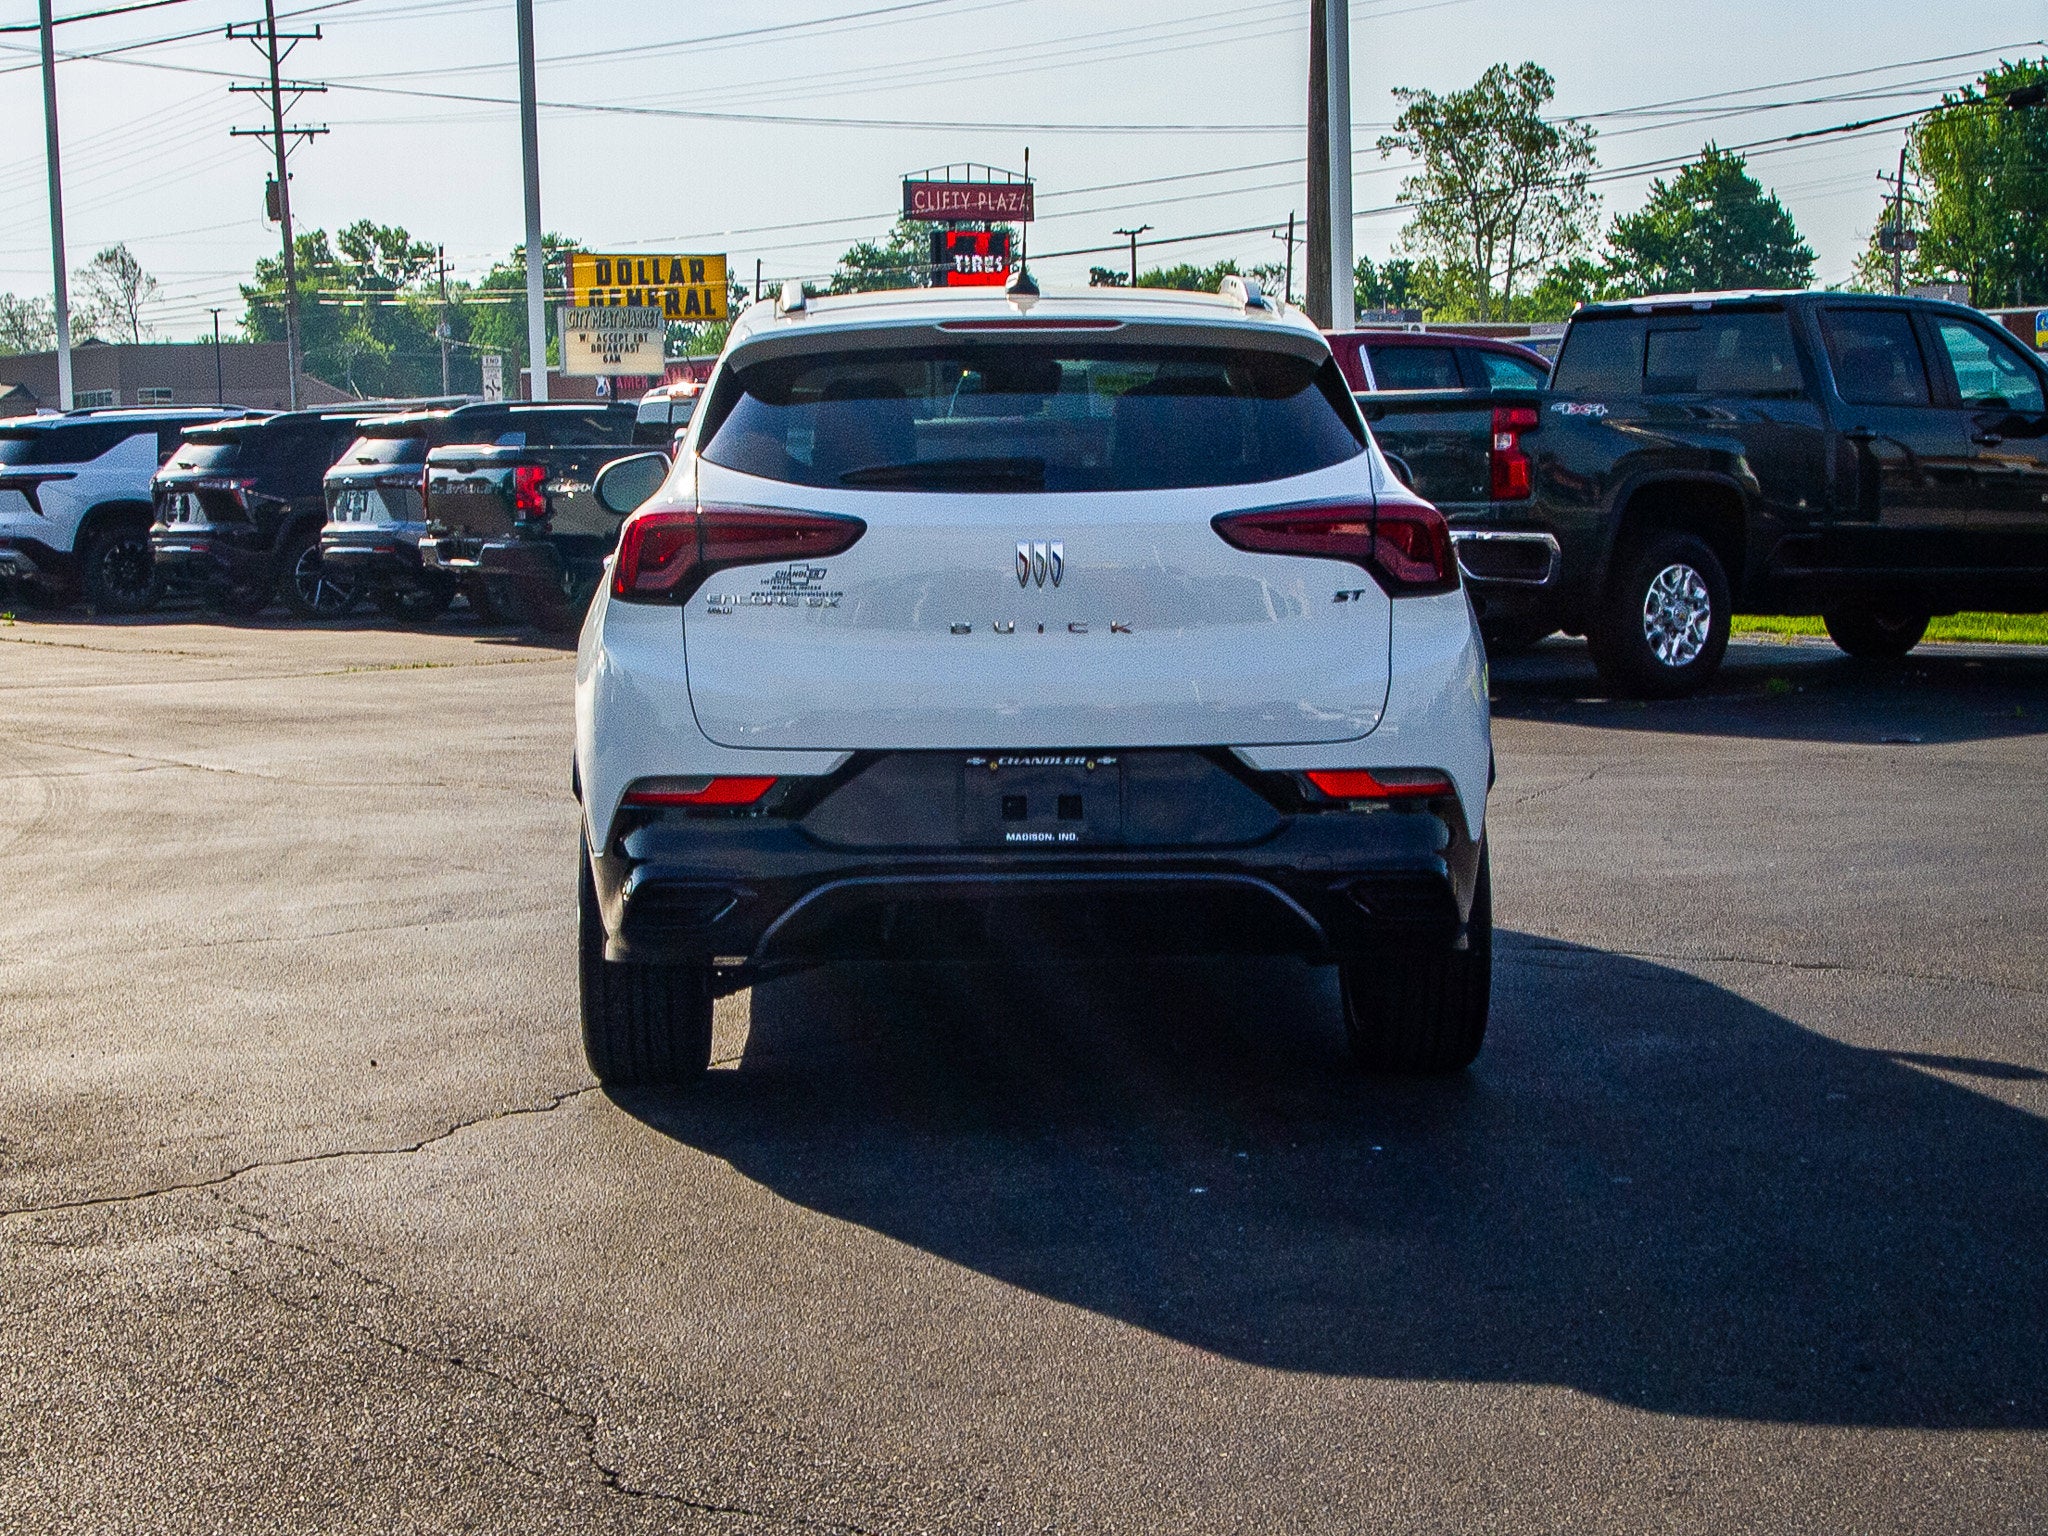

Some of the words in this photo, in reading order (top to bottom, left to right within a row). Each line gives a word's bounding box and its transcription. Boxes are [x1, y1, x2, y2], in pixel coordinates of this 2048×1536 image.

[914, 190, 970, 211] CLIFTY
[978, 191, 1030, 211] PLAZA
[955, 254, 1002, 272] TIRES
[595, 258, 705, 285] DOLLAR
[567, 309, 590, 329] CITY
[592, 309, 620, 328] MEAT
[621, 309, 660, 328] MARKET
[596, 333, 628, 343] ACCEPT
[591, 343, 640, 353] BREAKFAST
[603, 354, 621, 364] 6AM
[1332, 589, 1366, 603] ST
[949, 619, 1133, 635] BUICK
[998, 756, 1086, 766] CHANDLER
